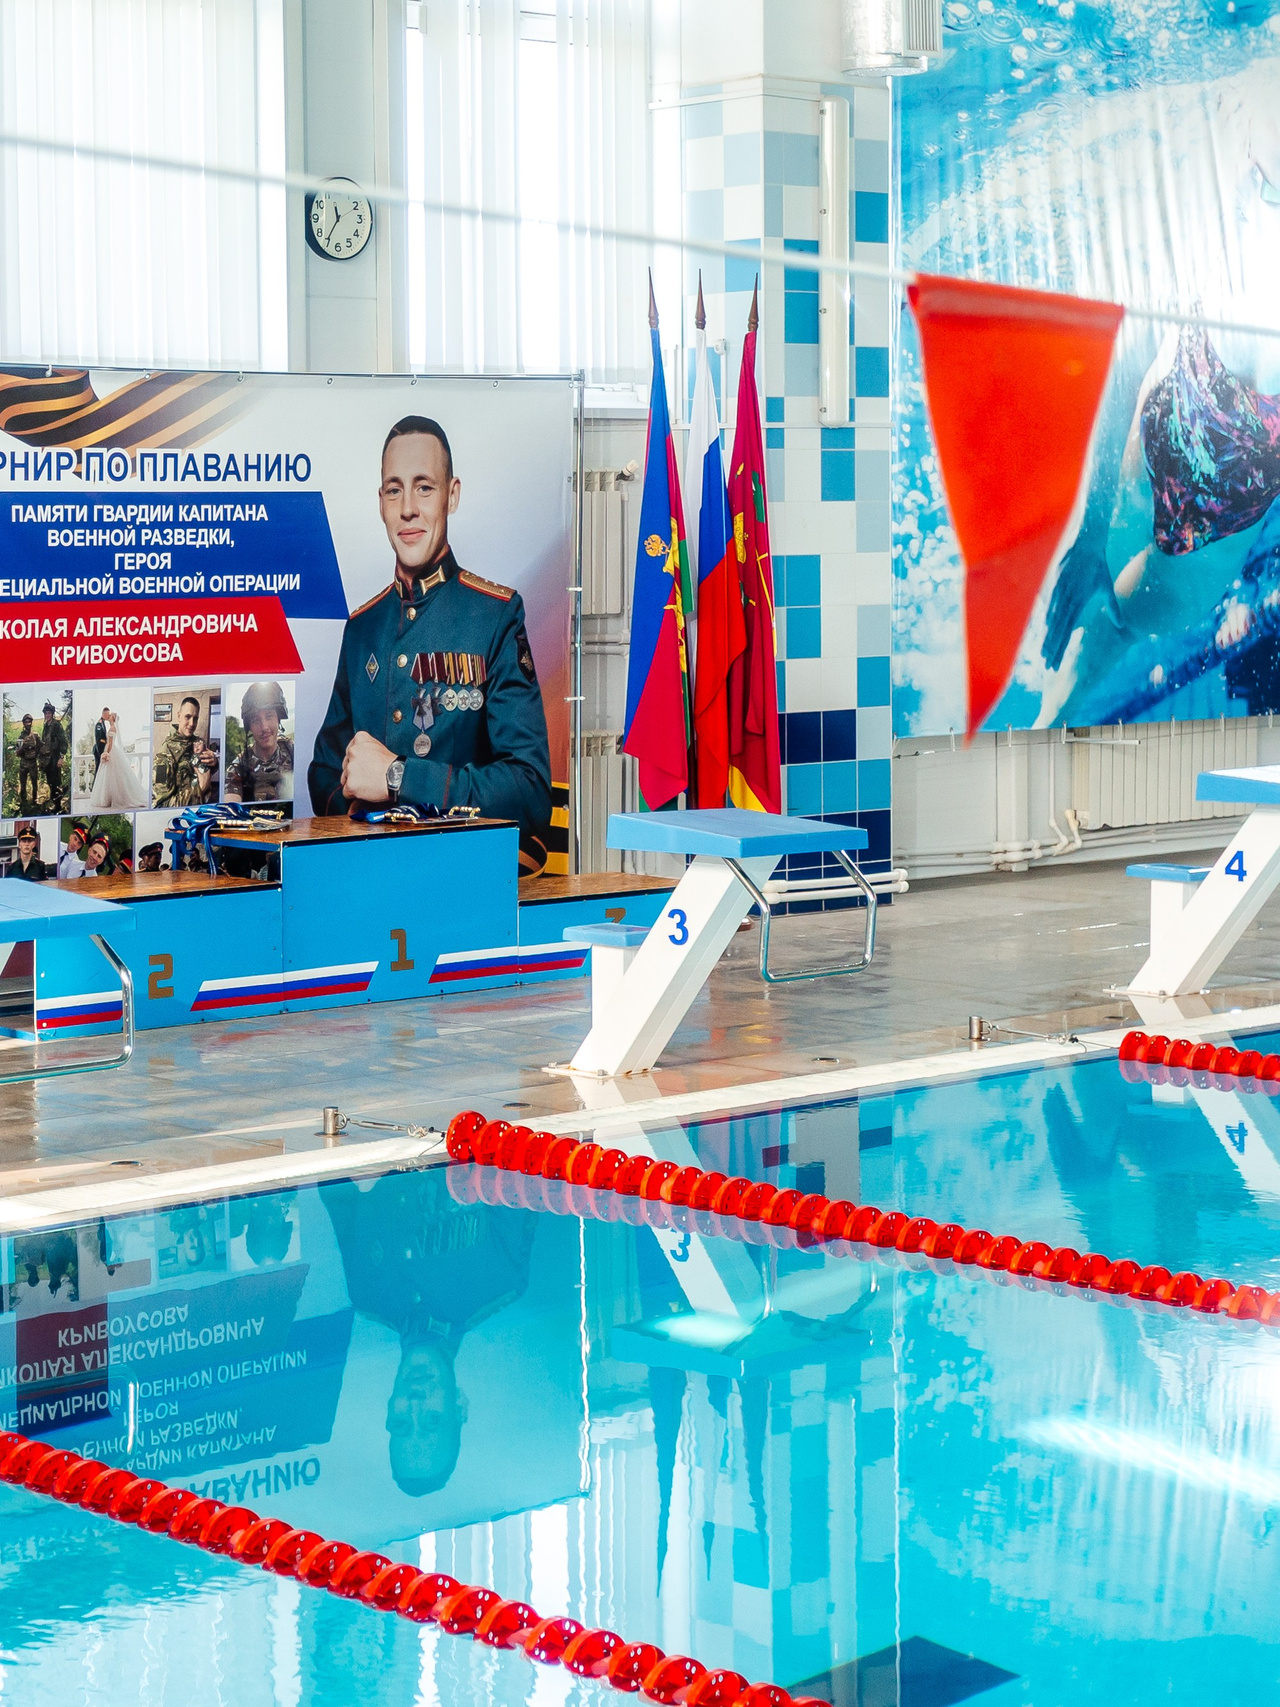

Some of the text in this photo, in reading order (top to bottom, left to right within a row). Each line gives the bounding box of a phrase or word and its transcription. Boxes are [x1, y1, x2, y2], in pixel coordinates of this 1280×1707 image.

[315, 200, 324, 209] 10
[352, 201, 359, 210] 2
[312, 213, 319, 223] 9
[356, 214, 363, 224] 3
[316, 228, 323, 237] 8
[346, 238, 352, 248] 5
[353, 229, 359, 238] 4
[334, 243, 342, 252] 6
[85, 452, 128, 482] ПО
[139, 452, 312, 482] ПЛАВАНИЮ
[11, 503, 269, 525] ПАМЯТИ ГВАРДИИ КАПИТАНА
[47, 524, 235, 548] ВОЕННОЙ РАЗВЕДКИ,
[114, 552, 172, 570] ГЕРОЯ
[119, 571, 205, 595] ВОЕННОЙ
[209, 573, 301, 594] ОПЕРАЦИИ
[73, 613, 259, 639] АЛЕКСАНДРОВИЧА
[50, 643, 184, 666] КРИВОУСОВА
[1224, 850, 1248, 882] 4
[667, 908, 690, 946] 3
[390, 928, 415, 972] 1
[148, 953, 175, 1000] 2
